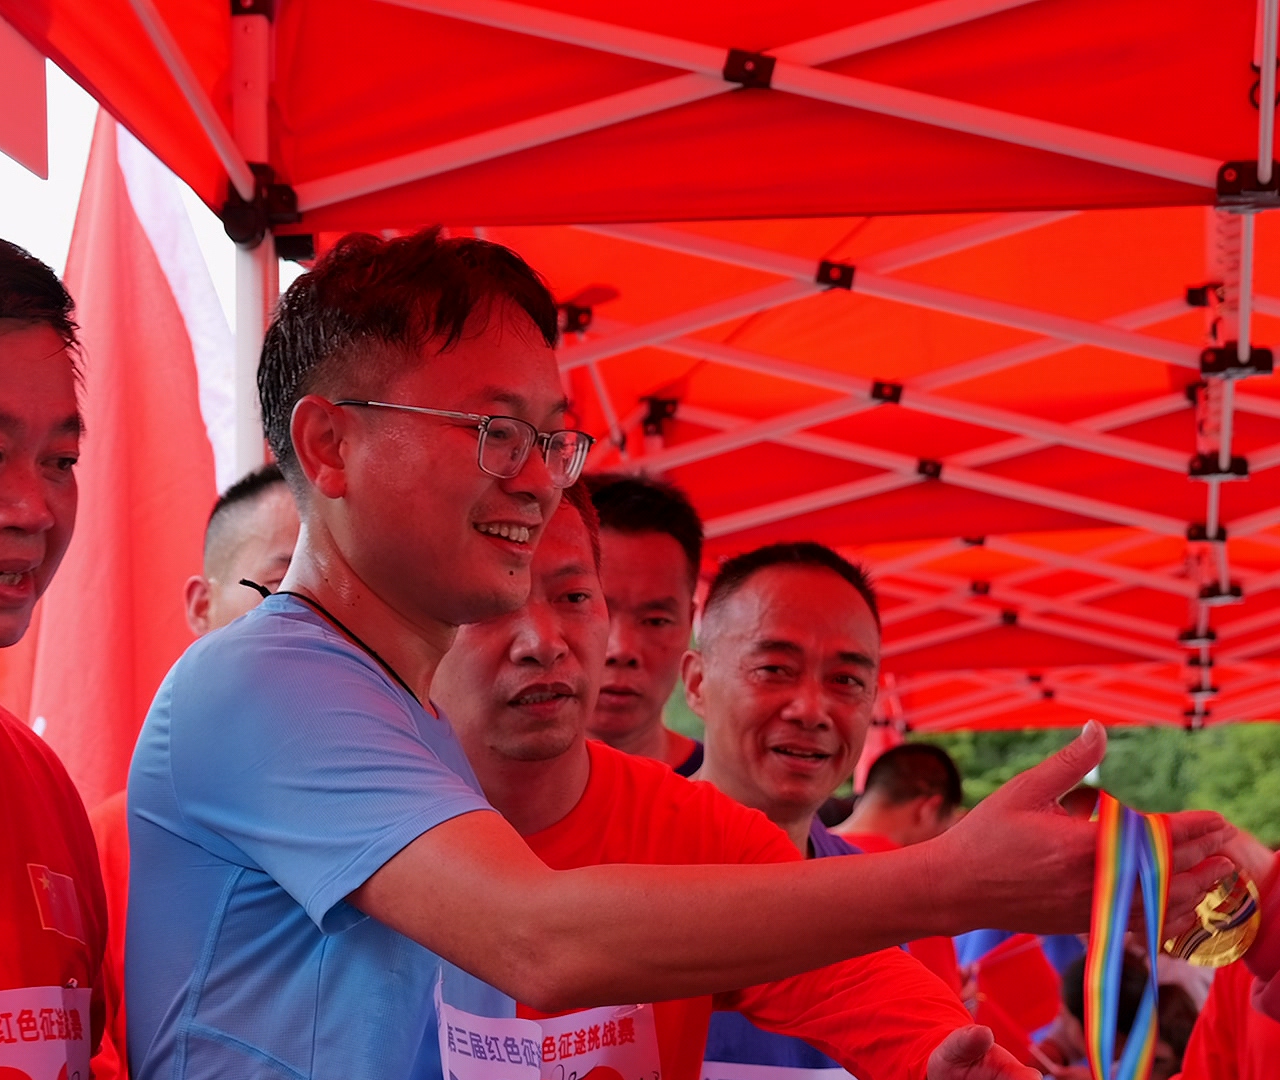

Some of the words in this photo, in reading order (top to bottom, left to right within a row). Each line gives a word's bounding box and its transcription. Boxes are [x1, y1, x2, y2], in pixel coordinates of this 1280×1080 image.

[542, 1017, 635, 1063] 色征途挑战赛
